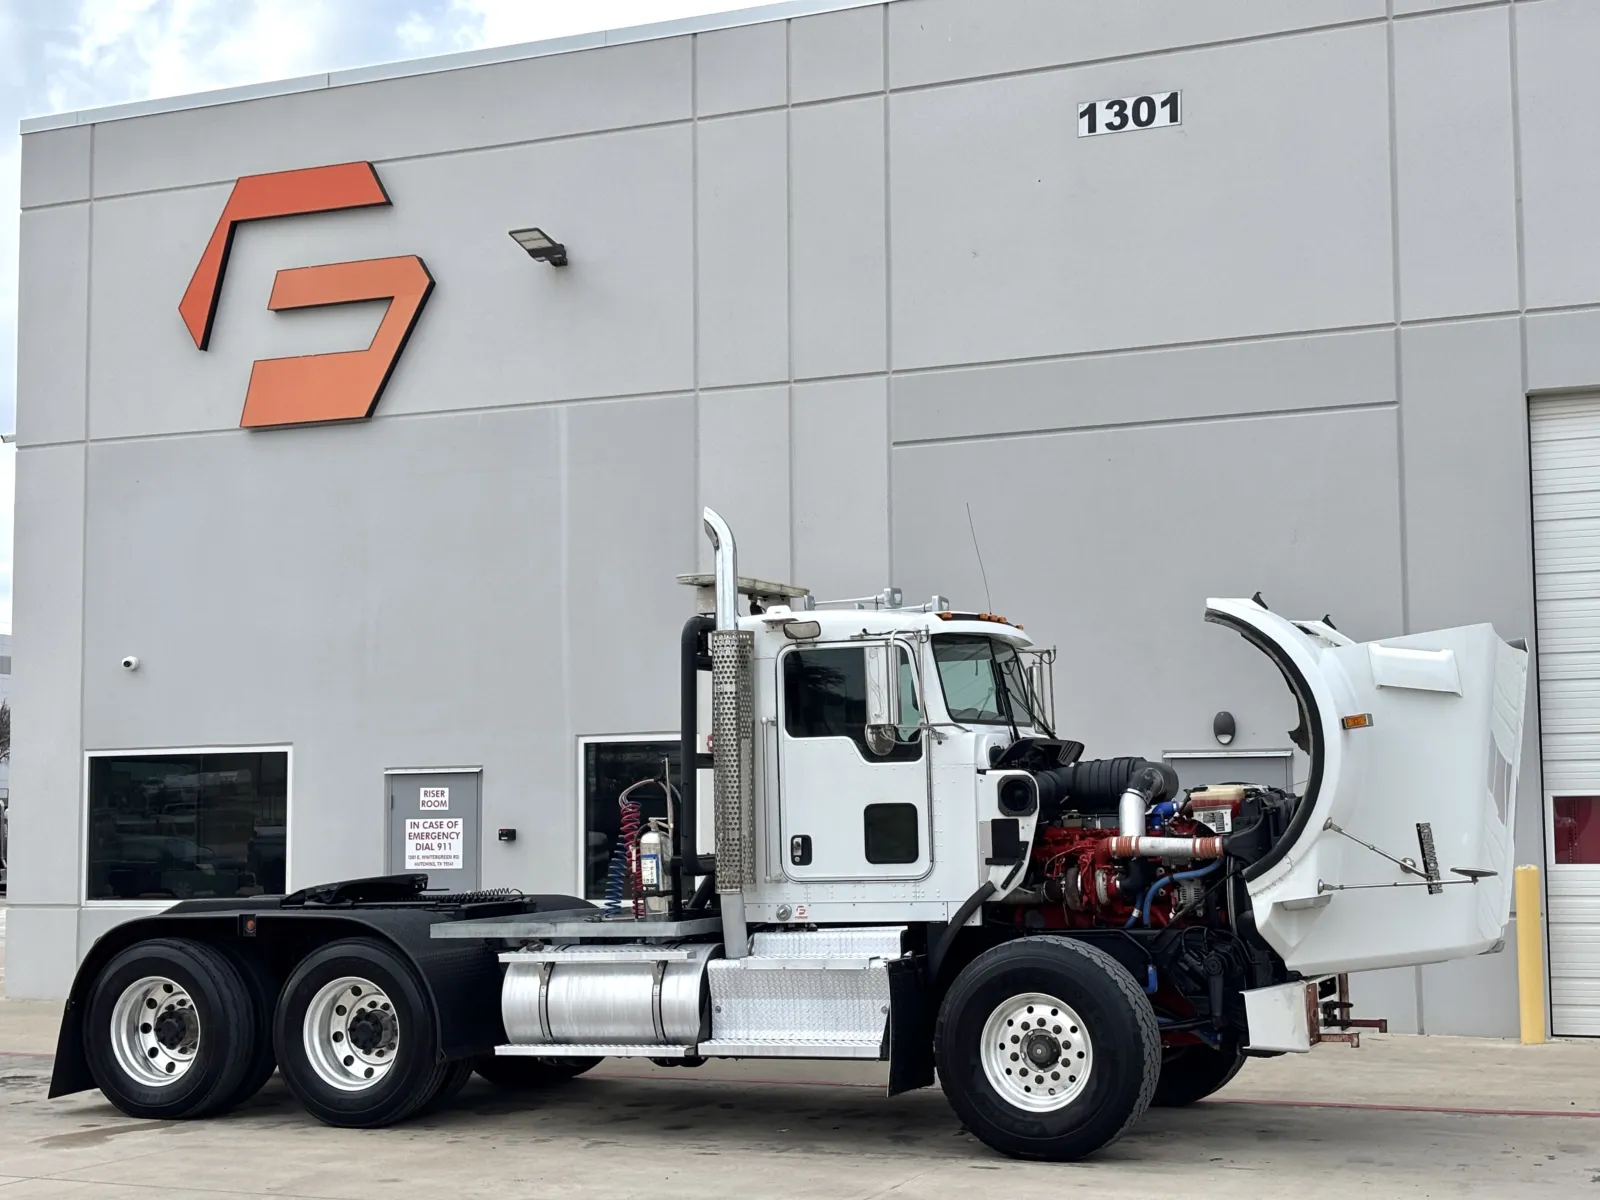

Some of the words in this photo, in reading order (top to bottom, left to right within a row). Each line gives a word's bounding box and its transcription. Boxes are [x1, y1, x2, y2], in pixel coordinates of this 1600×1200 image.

[1080, 92, 1179, 134] 1301
[423, 789, 446, 798] RISER
[421, 799, 448, 808] ROOM
[410, 821, 420, 829] IN
[422, 821, 444, 829] CASE
[446, 820, 459, 829] OF
[408, 831, 461, 840] EMERGENCY
[415, 842, 435, 851] DIAL
[437, 842, 452, 851] 911
